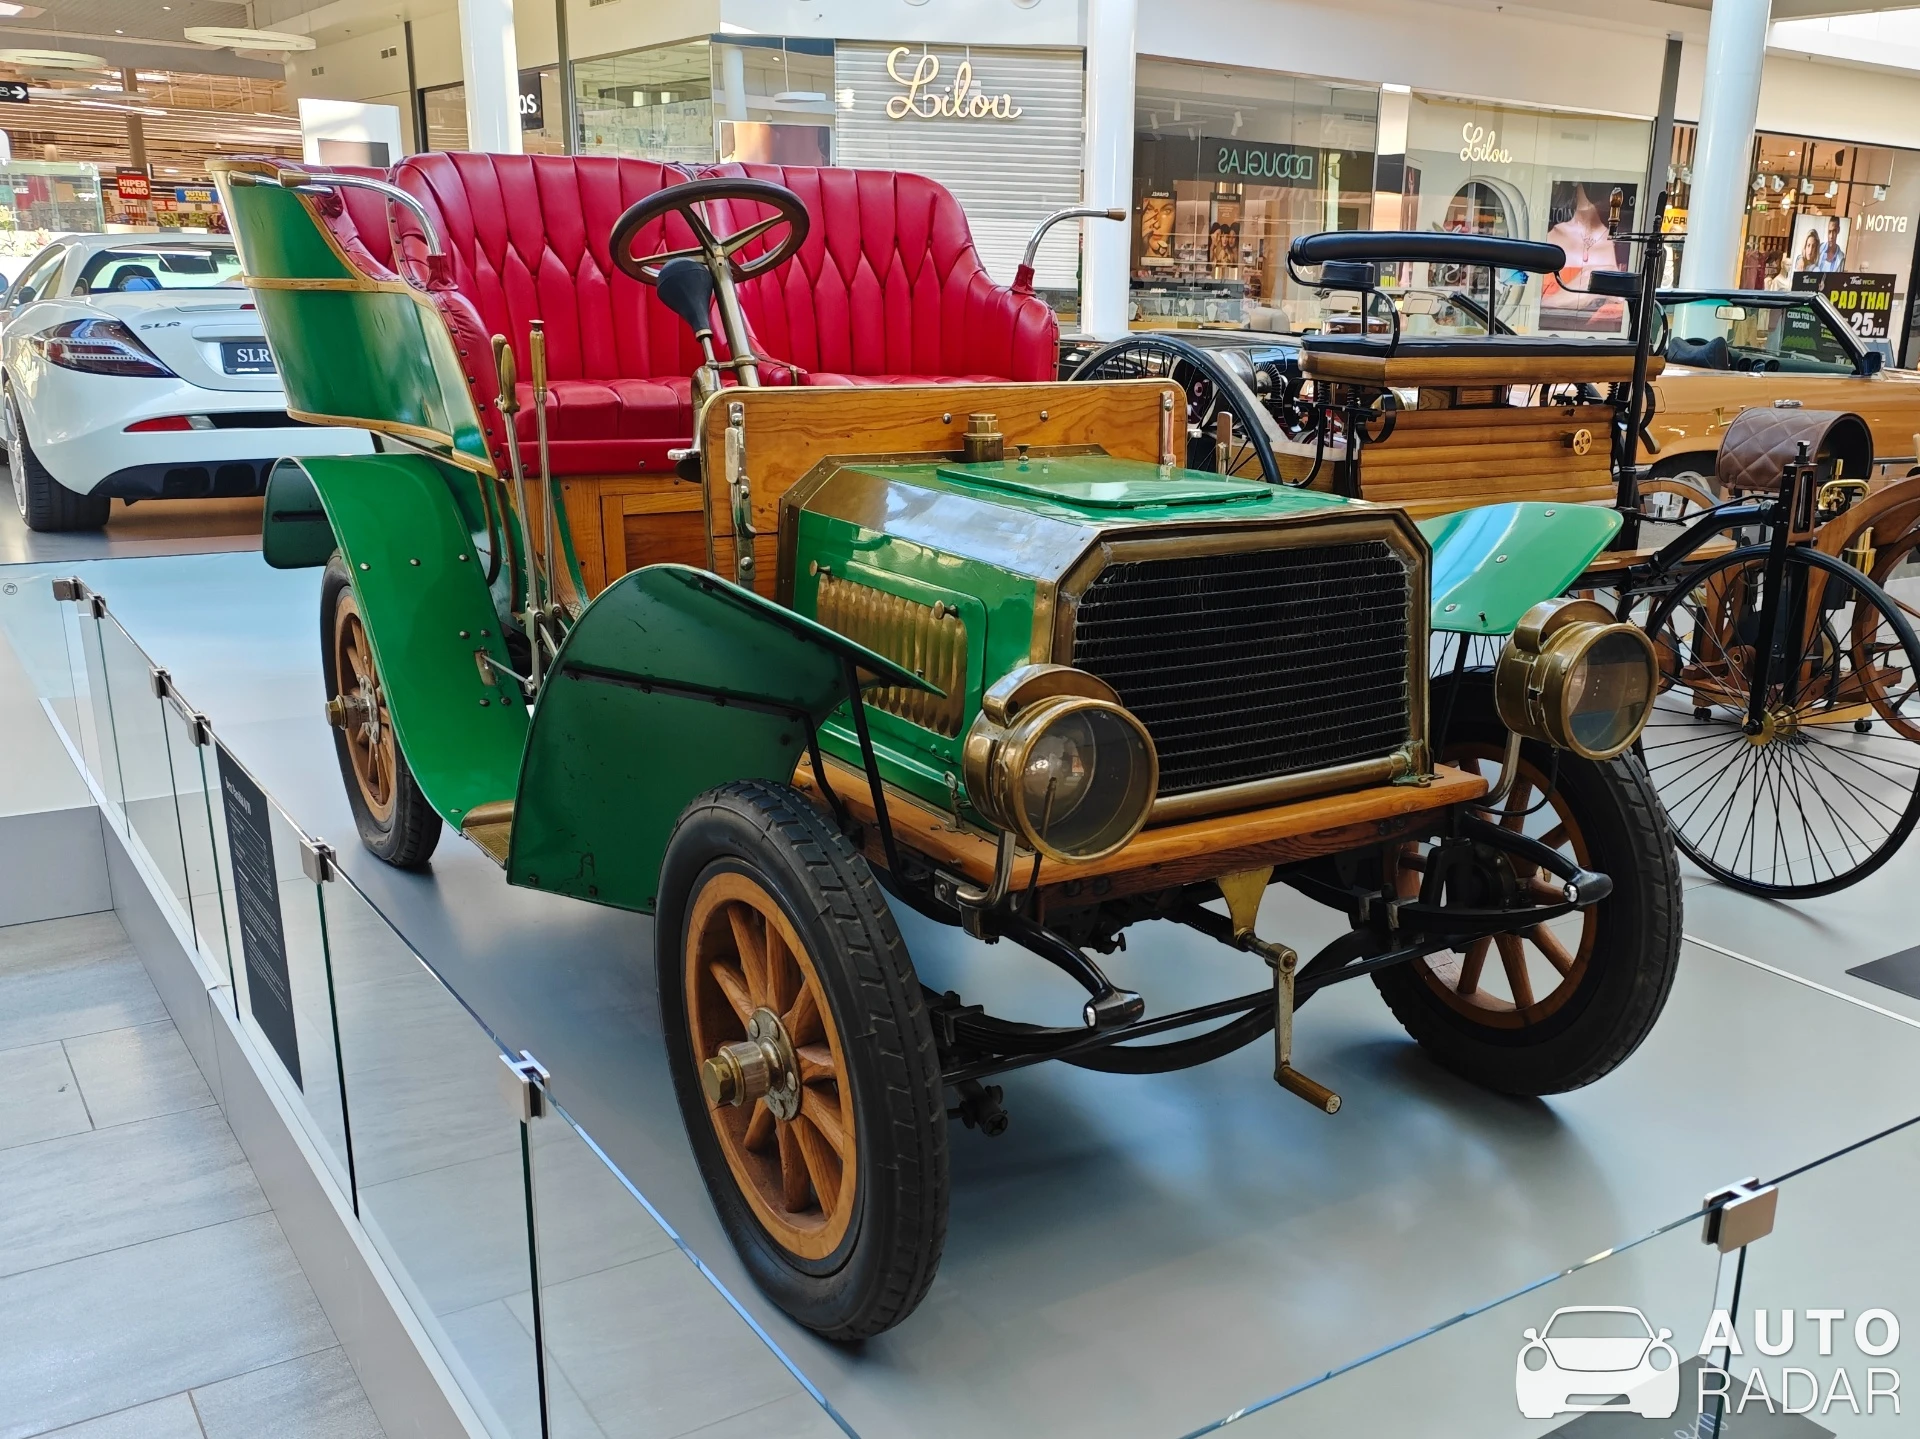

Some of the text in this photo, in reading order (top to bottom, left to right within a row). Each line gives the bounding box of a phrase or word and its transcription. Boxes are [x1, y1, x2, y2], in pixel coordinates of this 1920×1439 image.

[886, 46, 1023, 119] Lilou
[1460, 121, 1513, 164] Lilou
[118, 178, 148, 188] HIPER
[119, 186, 149, 196] TANIO
[1829, 290, 1891, 311] PAD THAI
[140, 321, 182, 332] SLR
[1850, 311, 1875, 337] 25
[236, 347, 272, 364] SLR
